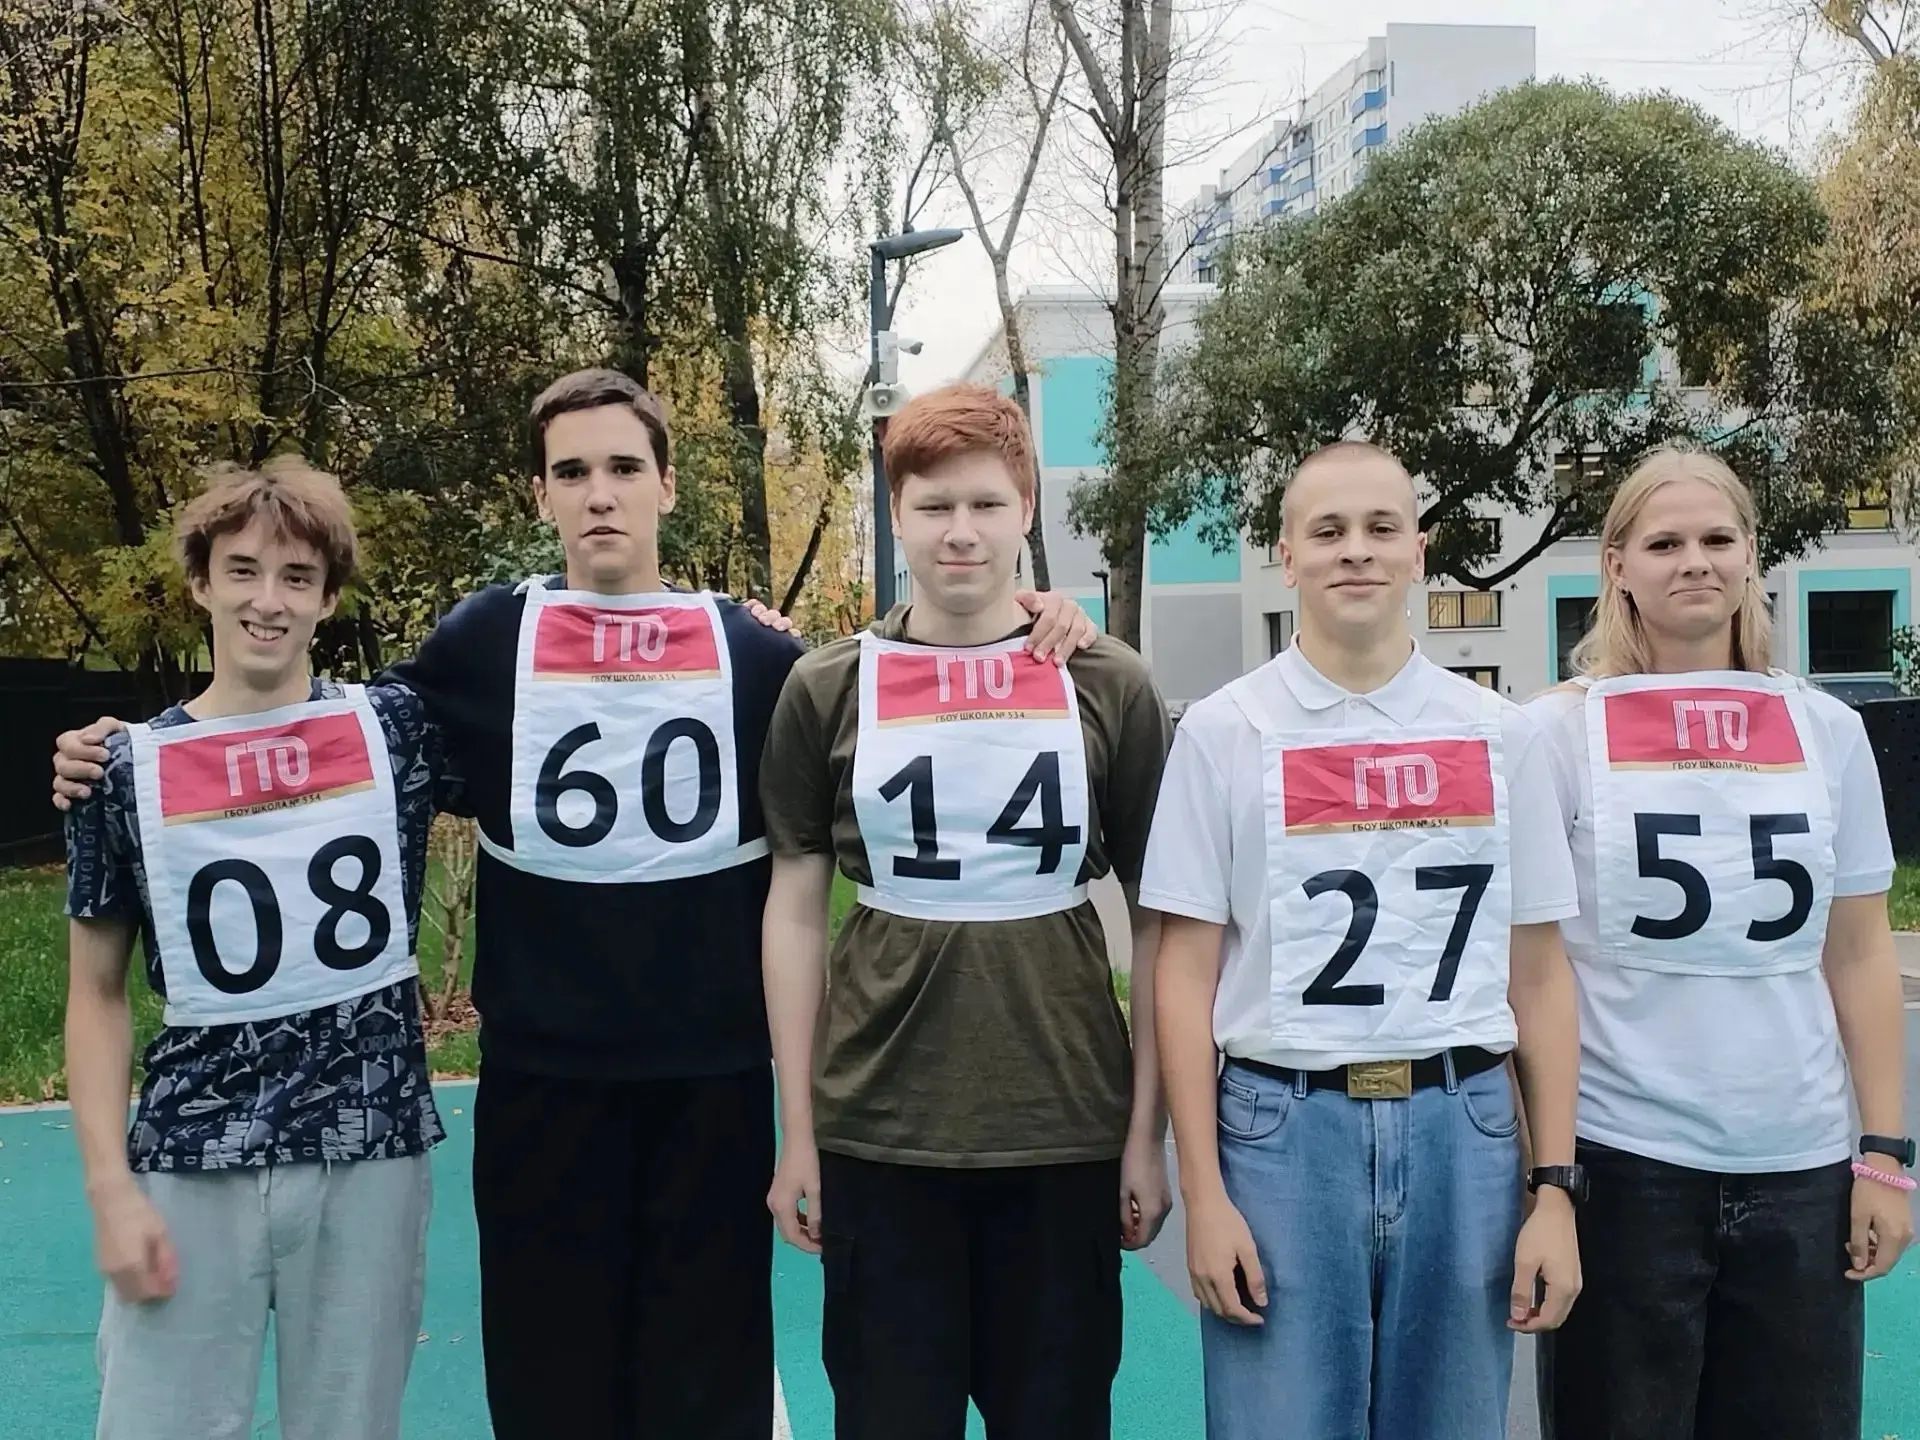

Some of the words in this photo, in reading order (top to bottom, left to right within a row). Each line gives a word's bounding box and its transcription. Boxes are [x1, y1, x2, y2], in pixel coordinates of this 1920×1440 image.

[592, 614, 668, 662] ГТО
[613, 673, 646, 682] ШКОЛА
[936, 652, 1013, 703] ГТО
[935, 714, 958, 723] ГБОУ
[960, 711, 994, 720] ШКОЛА
[1008, 710, 1025, 719] 534
[1673, 700, 1748, 752] ГТО
[225, 736, 309, 796] ГТО
[536, 718, 721, 847] 60
[1354, 754, 1439, 809] ГТО
[1672, 762, 1698, 771] ГБОУ
[1700, 760, 1735, 769] ШКОЛА
[224, 807, 250, 818] ГБОУ
[251, 800, 288, 814] ШКОЛА
[879, 752, 1081, 880] 14
[1352, 823, 1377, 832] ГБОУ
[1379, 820, 1415, 830] ШКОЛА
[1631, 813, 1813, 941] 55
[187, 835, 390, 994] 08
[1302, 864, 1493, 1006] 27
[327, 1096, 389, 1108] JORDAN
